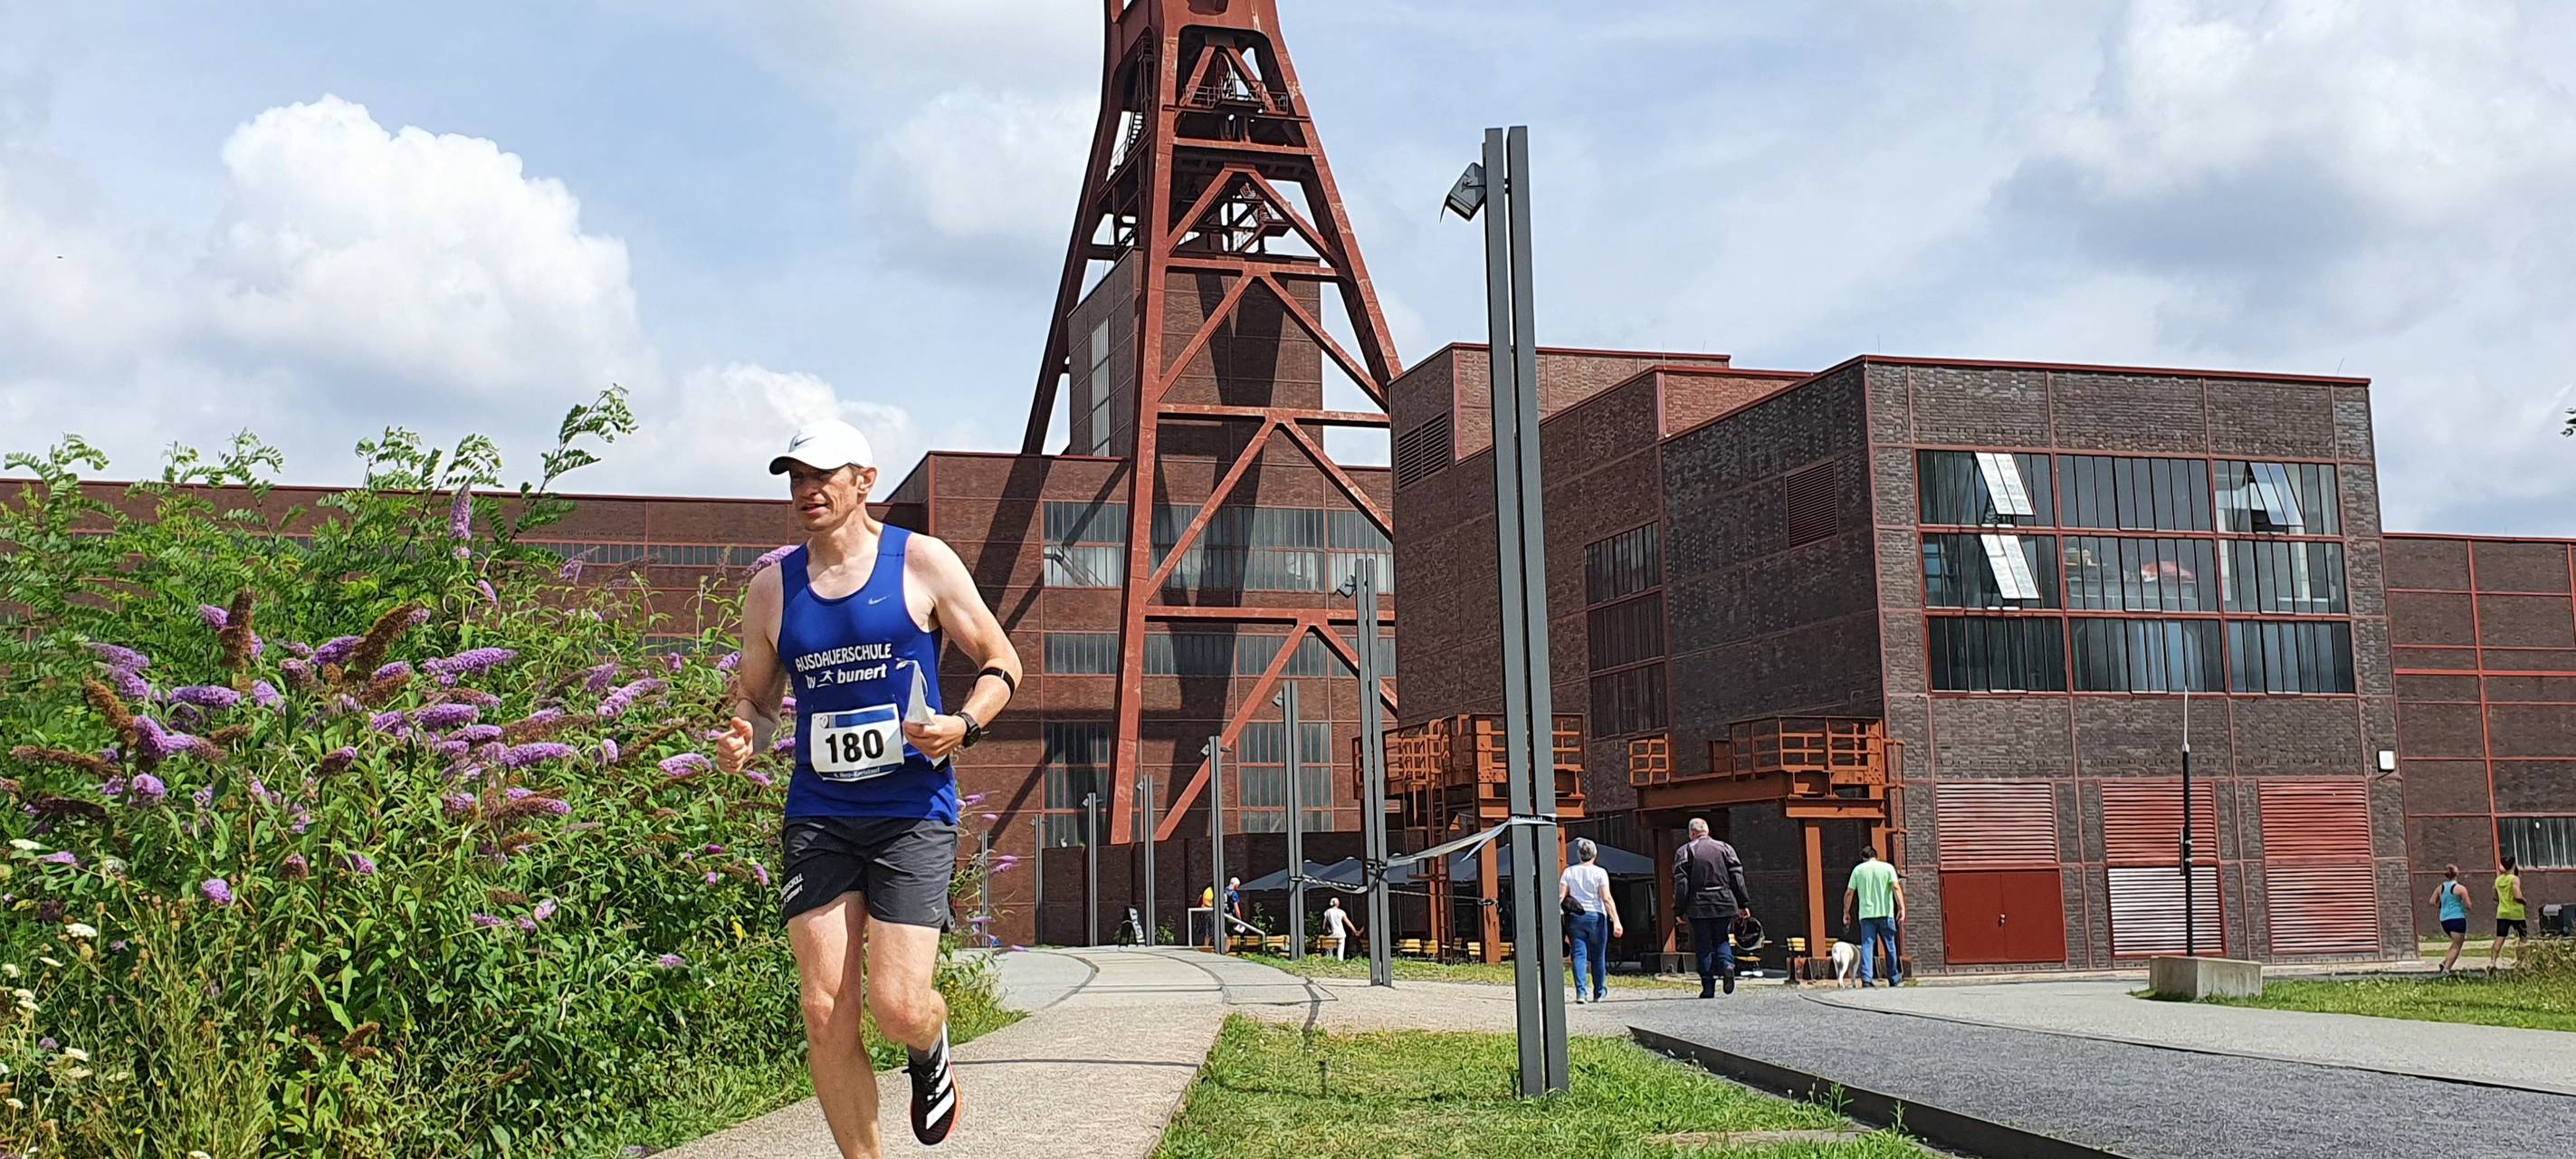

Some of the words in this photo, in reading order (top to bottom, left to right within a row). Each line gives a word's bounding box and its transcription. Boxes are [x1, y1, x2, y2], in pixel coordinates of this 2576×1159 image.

[795, 643, 892, 672] AUSDAUERSCHULE
[805, 675, 816, 689] by
[837, 663, 887, 684] bunert
[825, 729, 883, 763] 180
